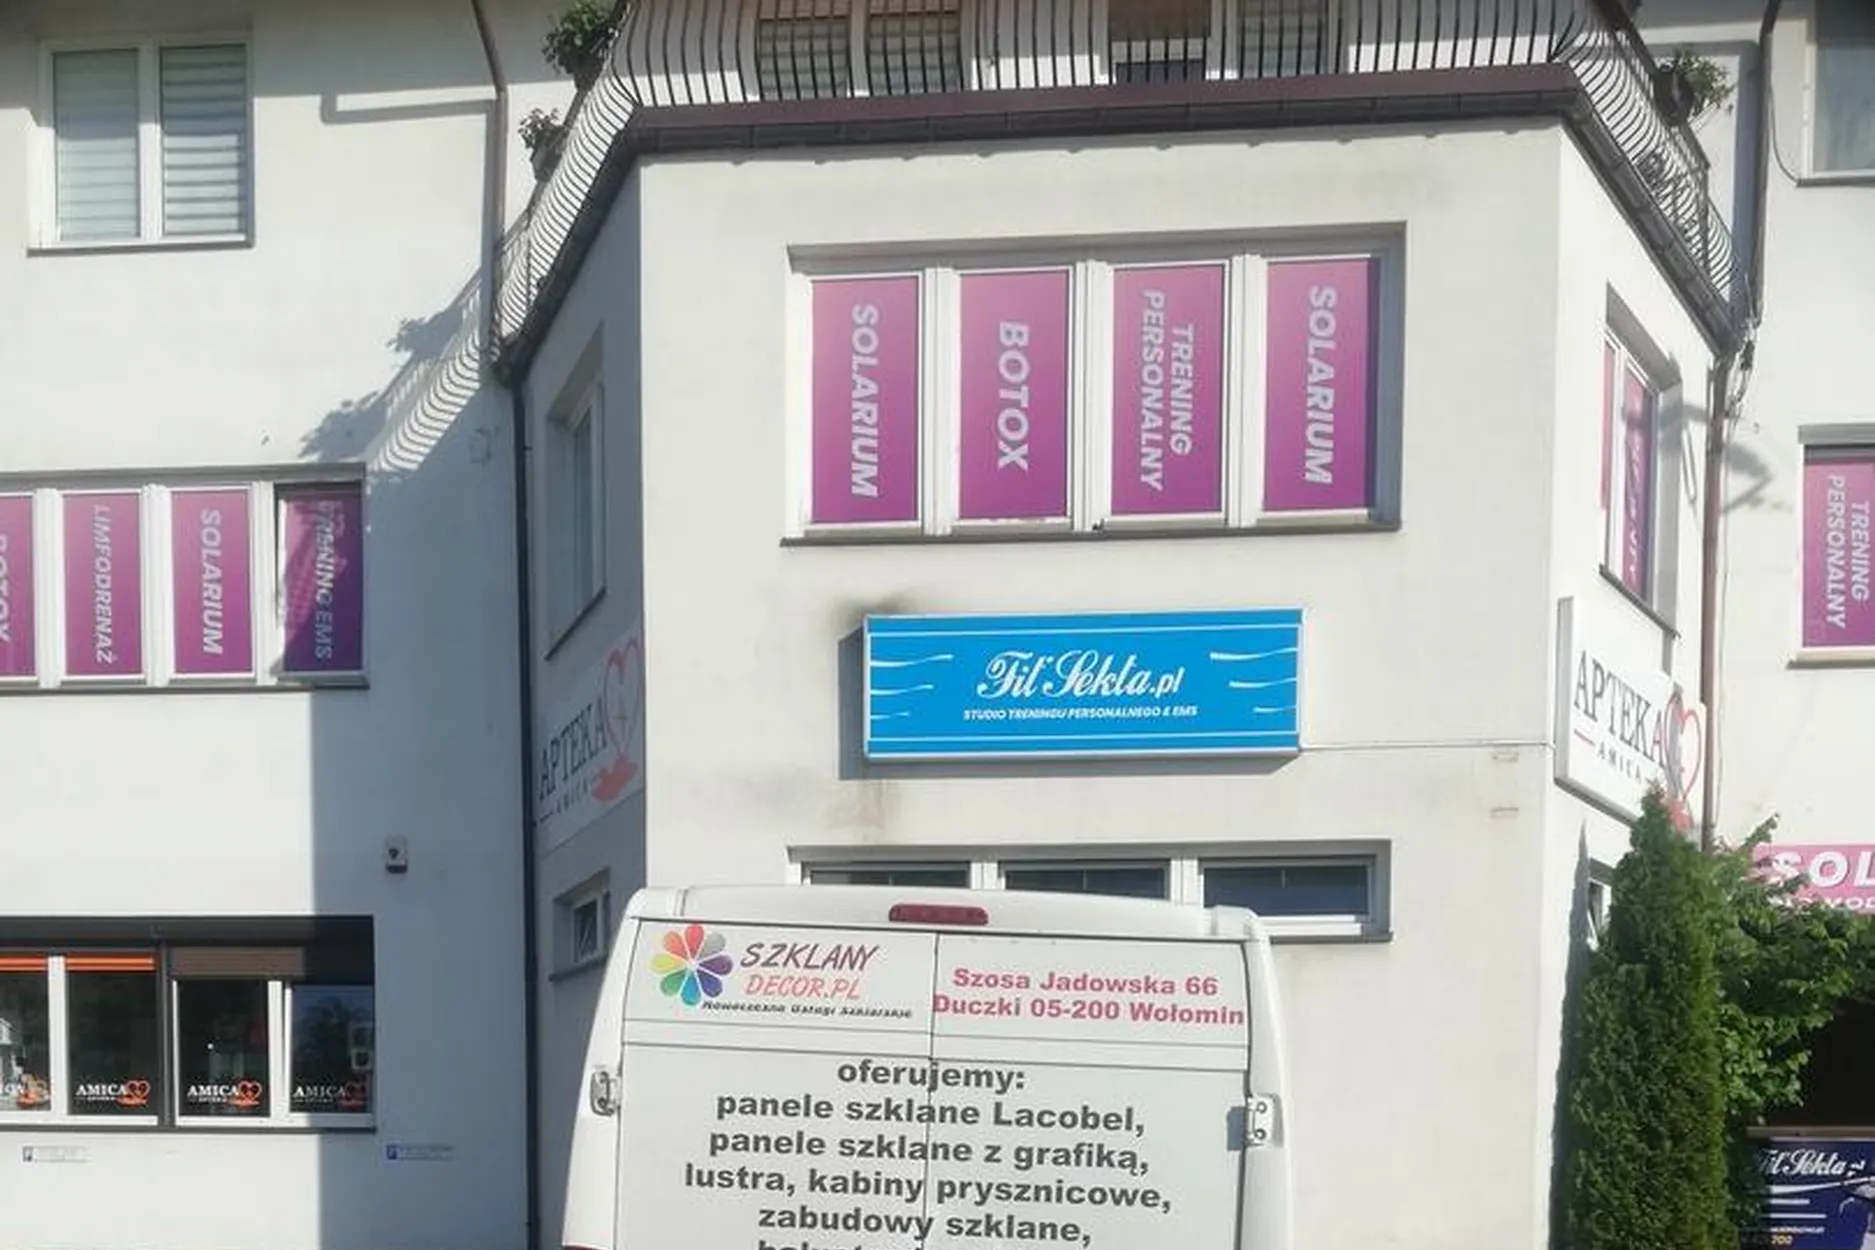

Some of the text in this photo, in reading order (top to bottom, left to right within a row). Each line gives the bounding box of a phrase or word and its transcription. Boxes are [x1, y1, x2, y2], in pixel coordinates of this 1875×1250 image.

[851, 303, 879, 498] SOLARIUM
[996, 320, 1030, 472] BOTOX
[1139, 289, 1166, 491] PERSONALNY
[1169, 323, 1195, 456] TRENING
[1303, 285, 1338, 485] SOLARIUM
[1825, 473, 1847, 628] PERSONALNY
[1850, 500, 1871, 602] TRENING
[200, 509, 224, 656] SOLARIUM
[314, 611, 334, 660] EMS
[963, 709, 1006, 721] STUDIO
[1068, 706, 1164, 720] PERSONALNEGO
[1172, 705, 1199, 717] EMS
[1574, 650, 1665, 769] APTEKA
[538, 697, 608, 800] APTEKA
[740, 942, 880, 971] SZKLANY
[745, 974, 861, 999] DECOR.PL
[953, 967, 1218, 996] Szosa Jadowska 66
[932, 994, 1244, 1025] Duczki 05-200 Wołomin
[76, 1083, 128, 1097] AMICA
[187, 1084, 239, 1098] AMICA
[293, 1084, 347, 1099] AMICA
[837, 1060, 1025, 1095] oferujemy:
[717, 1093, 1145, 1138] panele szklane Lacobel,
[709, 1130, 1149, 1177] panele szklane z grafiką,
[685, 1162, 1172, 1214] lustra, kabiny prysznicowe,
[758, 1204, 1092, 1249] zabudowy szklane,
